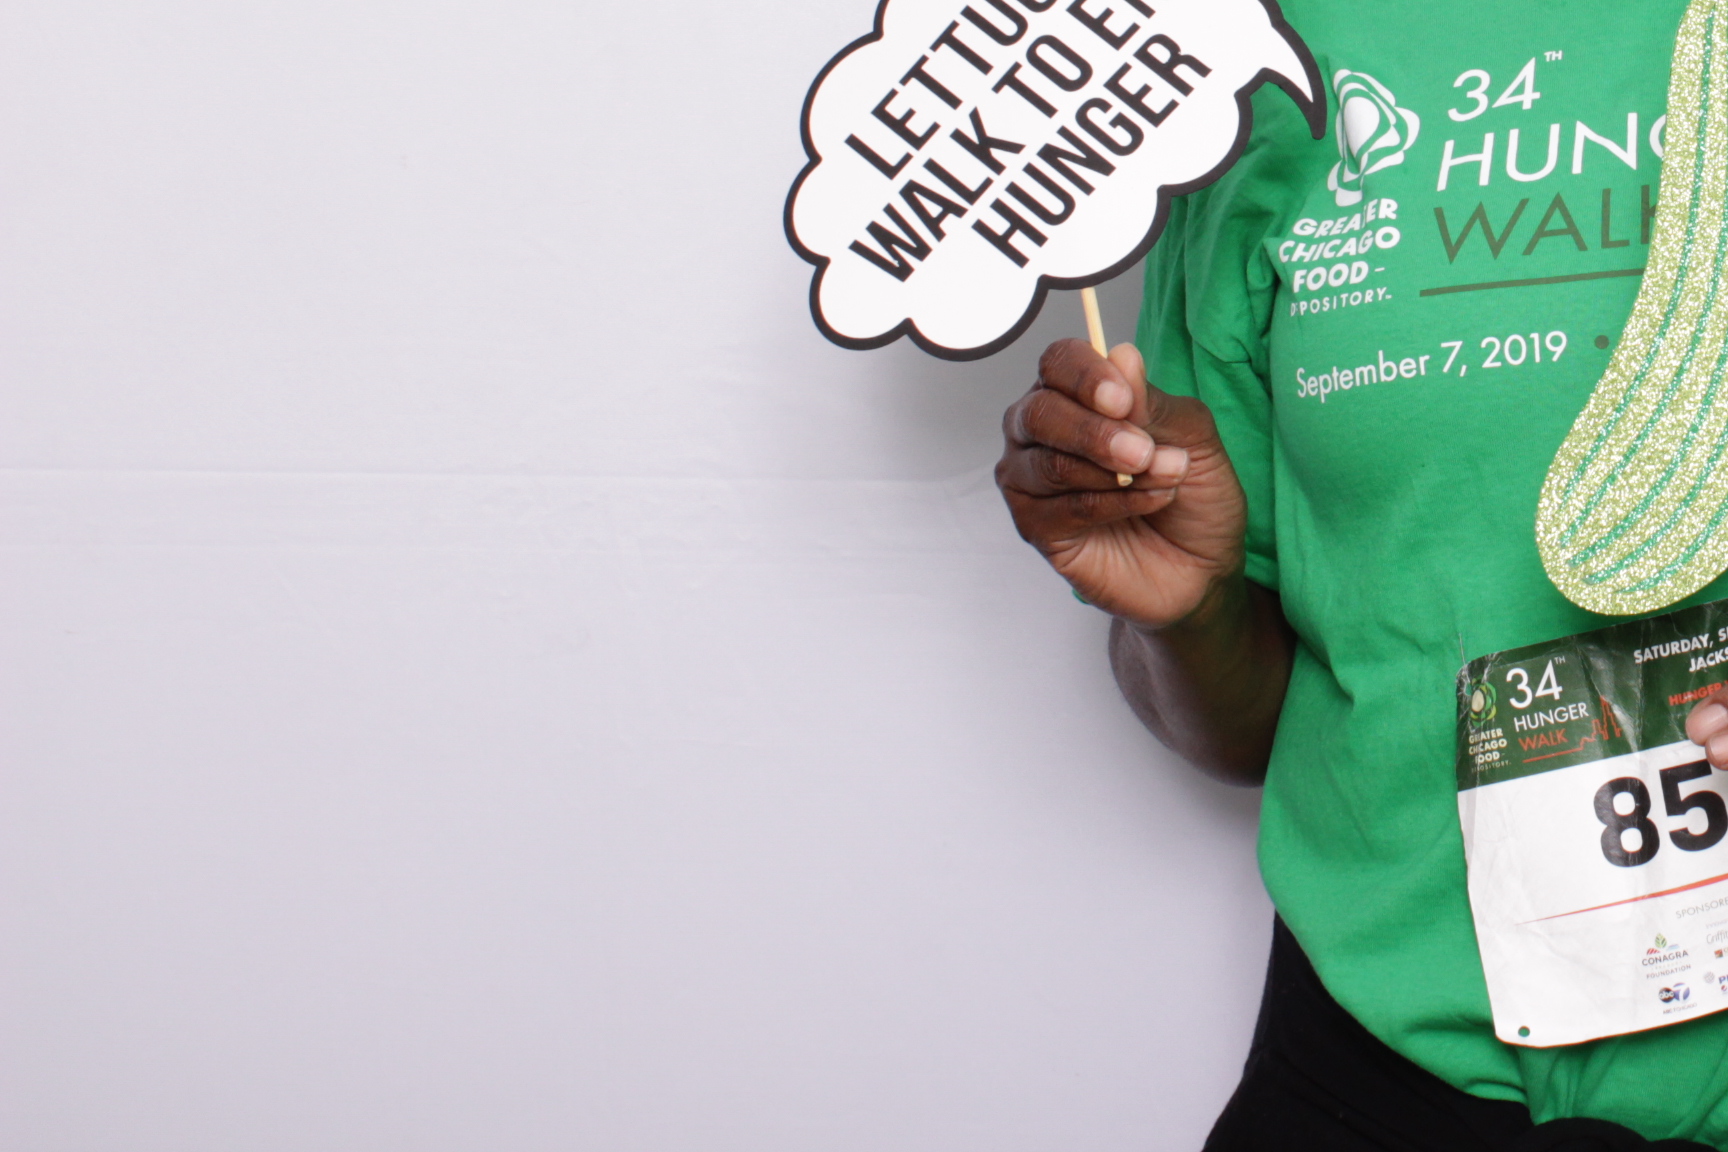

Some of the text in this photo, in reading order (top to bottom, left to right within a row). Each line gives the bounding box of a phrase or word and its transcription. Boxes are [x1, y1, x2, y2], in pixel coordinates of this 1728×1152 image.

[848, 107, 1026, 282] WALK
[991, 35, 1093, 119] TO
[971, 34, 1212, 269] HUNGER
[1436, 112, 1667, 191] HUN
[1293, 198, 1398, 239] GREAER
[1279, 226, 1400, 263] CHICAGO
[1290, 287, 1388, 317] DPOSITORY
[1296, 350, 1430, 403] September
[1441, 341, 1466, 377] 7,
[1480, 330, 1568, 368] 2019
[1633, 633, 1714, 664] SATURDAY,
[1513, 702, 1590, 733] HUNGER
[1518, 729, 1569, 751] WALK
[1641, 949, 1689, 967] CONAGRA
